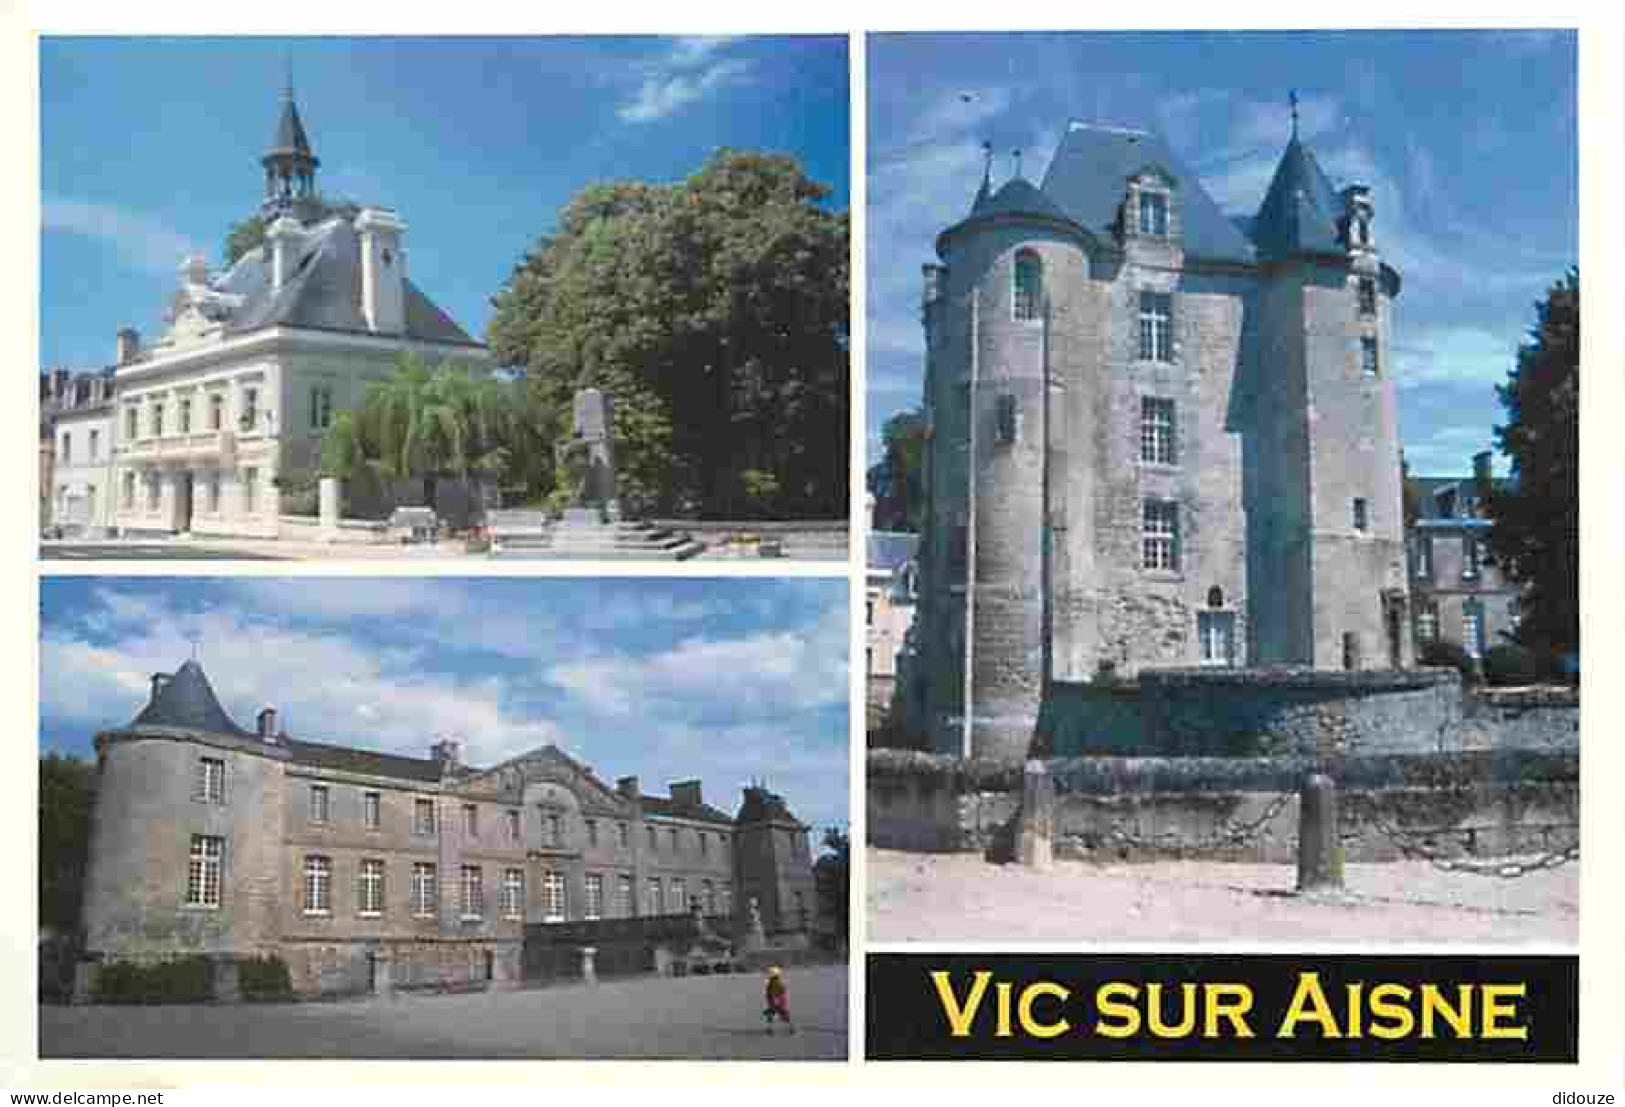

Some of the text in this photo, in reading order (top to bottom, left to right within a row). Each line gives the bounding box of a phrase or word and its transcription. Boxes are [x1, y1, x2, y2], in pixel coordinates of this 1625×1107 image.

[932, 970, 1528, 1040] VIC SUR AISNE
